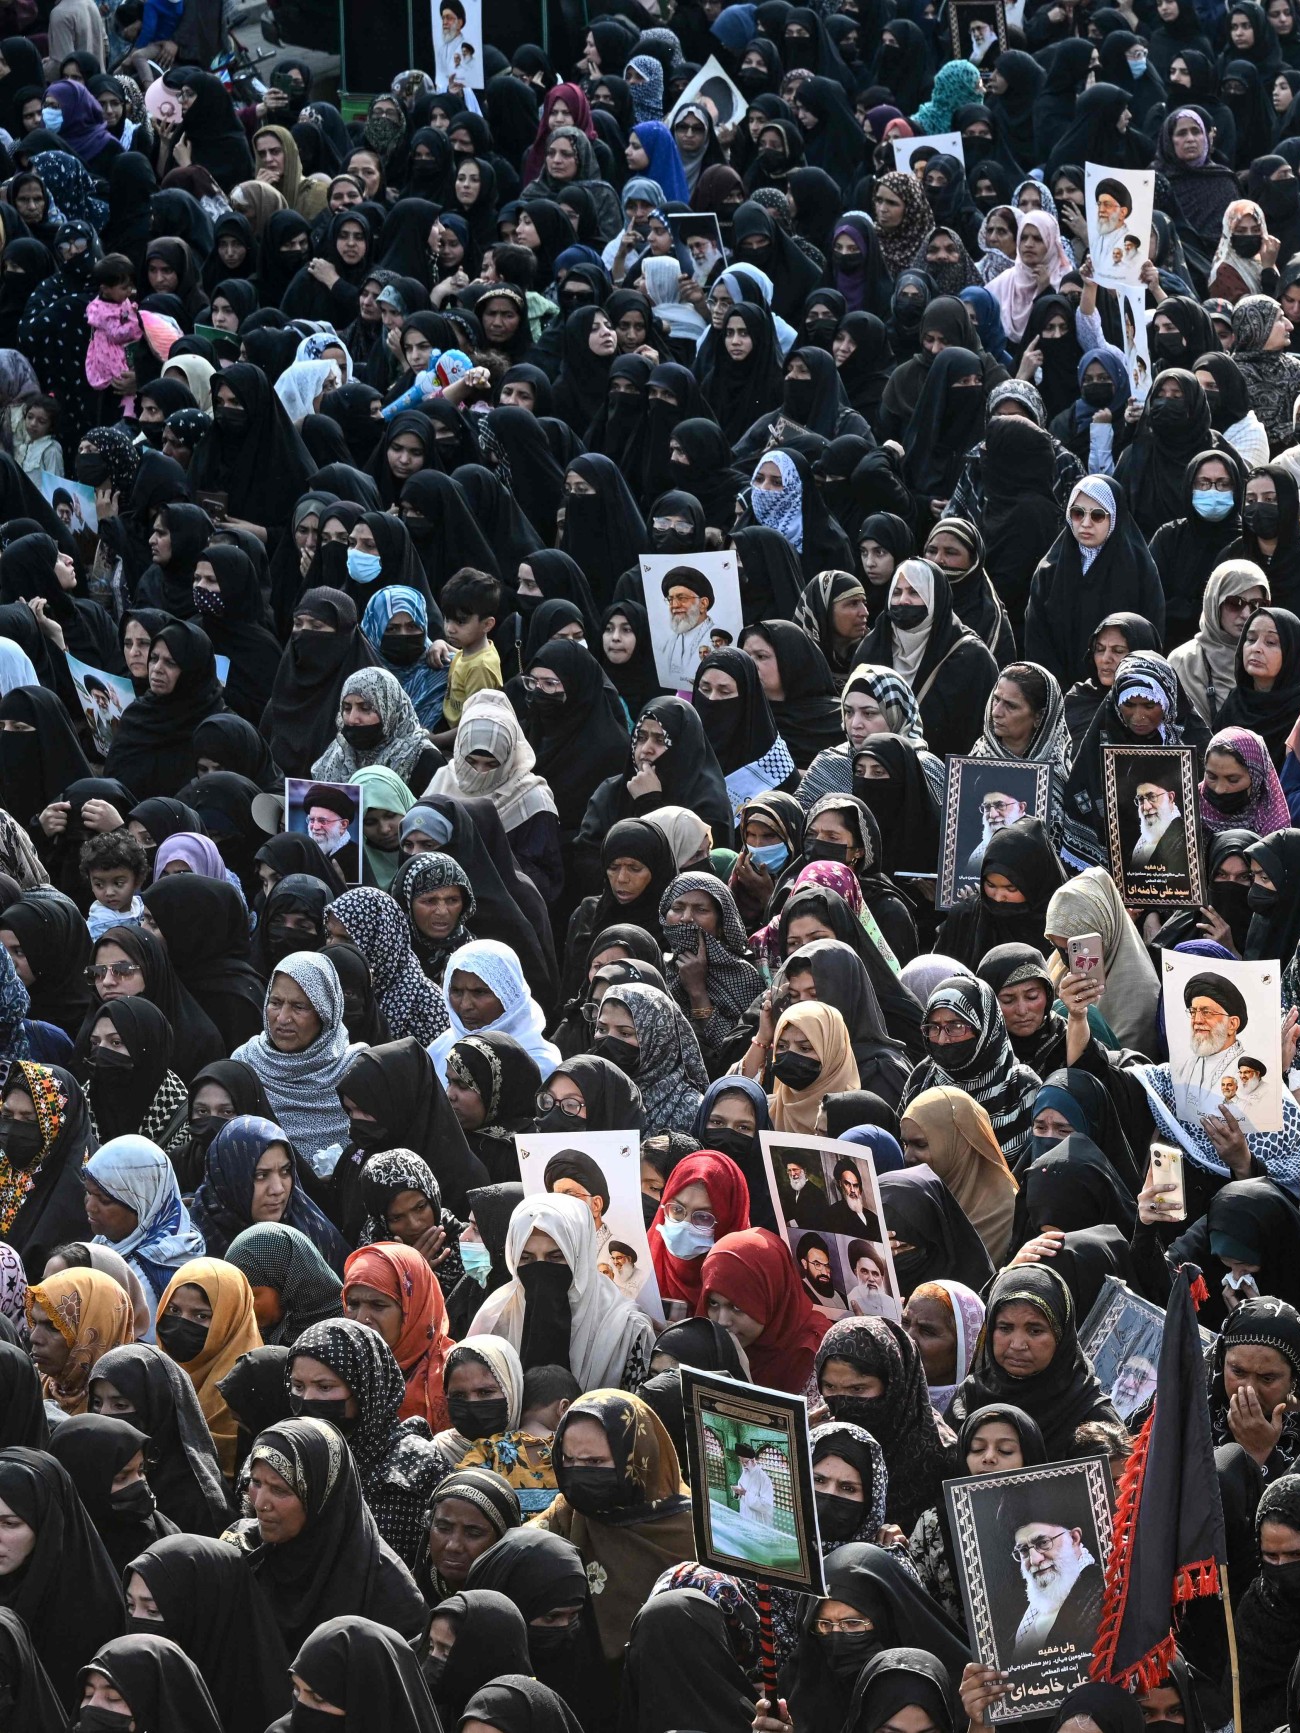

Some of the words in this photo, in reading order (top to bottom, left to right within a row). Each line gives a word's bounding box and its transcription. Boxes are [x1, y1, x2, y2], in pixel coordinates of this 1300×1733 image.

[1160, 885, 1173, 897] علی
[1174, 888, 1189, 897] سید
[1038, 1645, 1059, 1657] فقیہ
[1060, 1642, 1076, 1654] ولی
[1021, 1661, 1042, 1670] مسلمین
[1028, 1678, 1065, 1696] خامنہ
[1066, 1672, 1090, 1693] علی
[1010, 1683, 1026, 1701] ای
